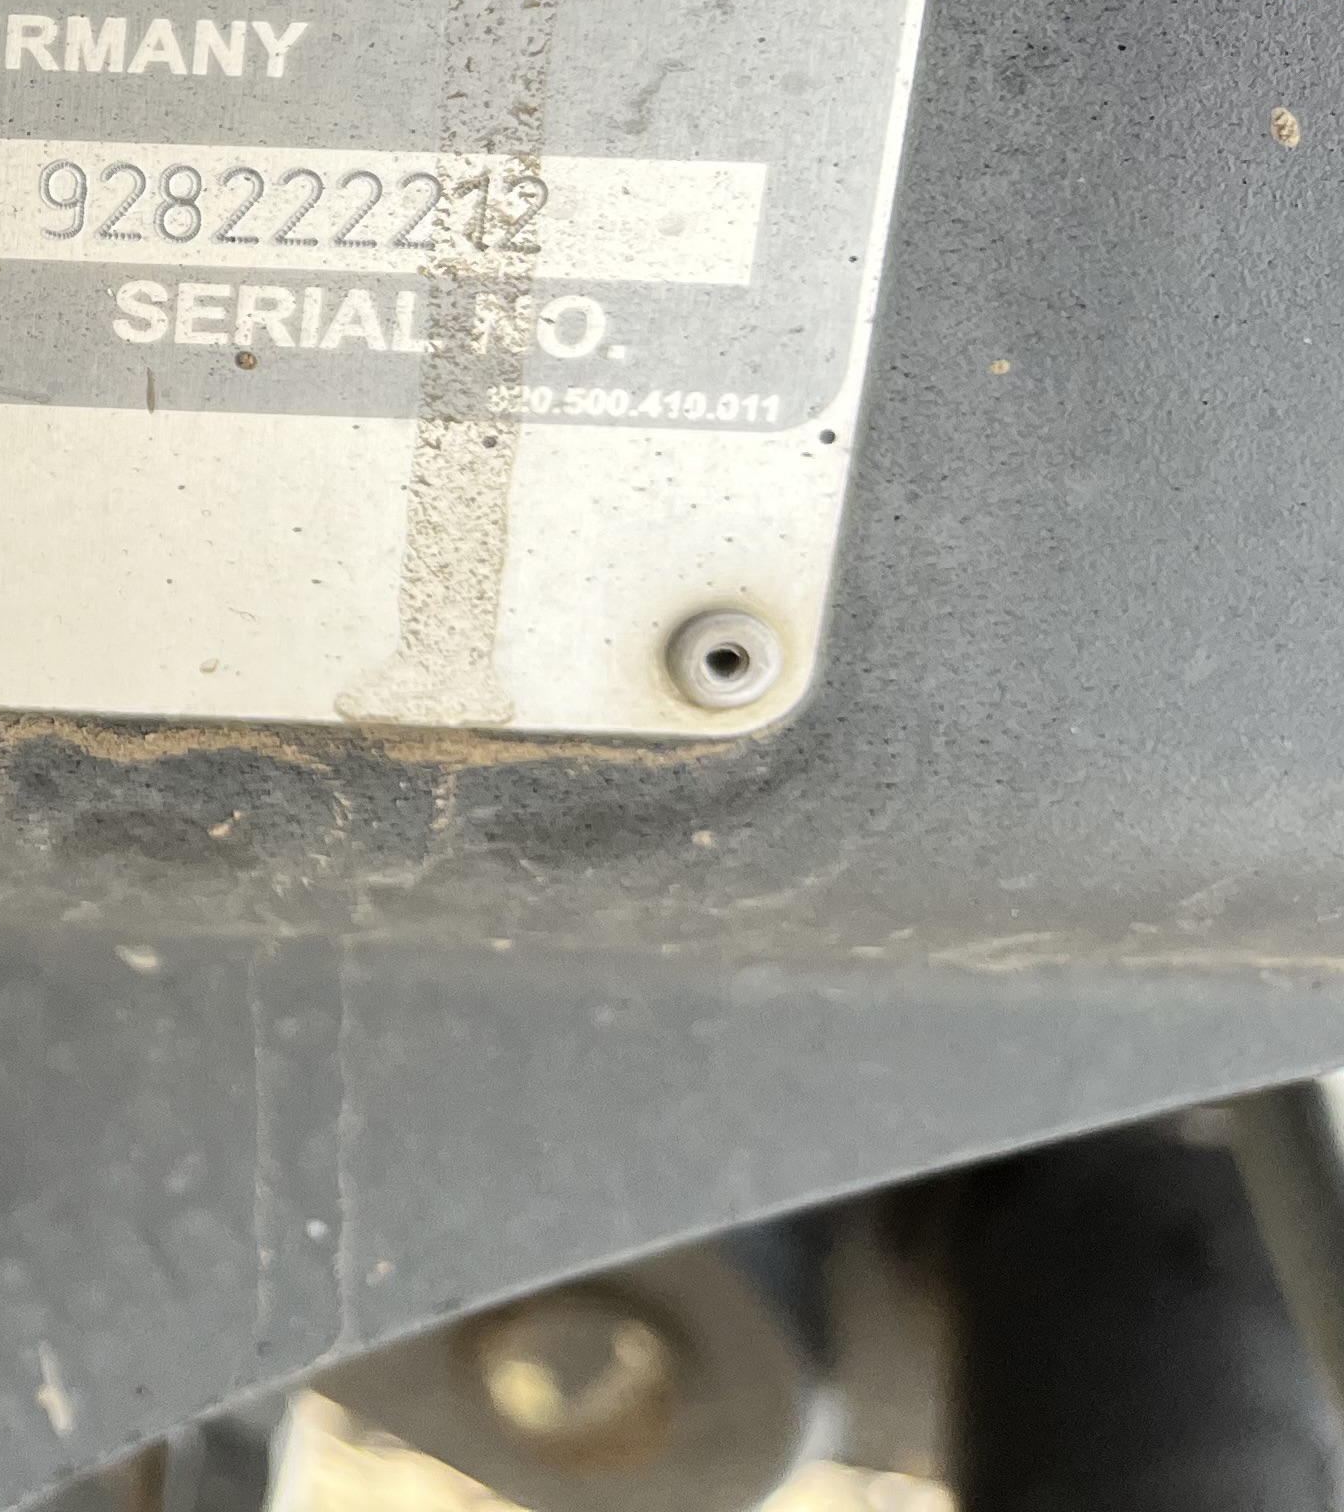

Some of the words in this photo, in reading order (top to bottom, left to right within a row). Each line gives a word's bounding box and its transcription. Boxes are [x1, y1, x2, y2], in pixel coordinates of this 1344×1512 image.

[38, 158, 549, 254] 928222212
[111, 278, 443, 354] SERIAL
[473, 292, 626, 360] NO.
